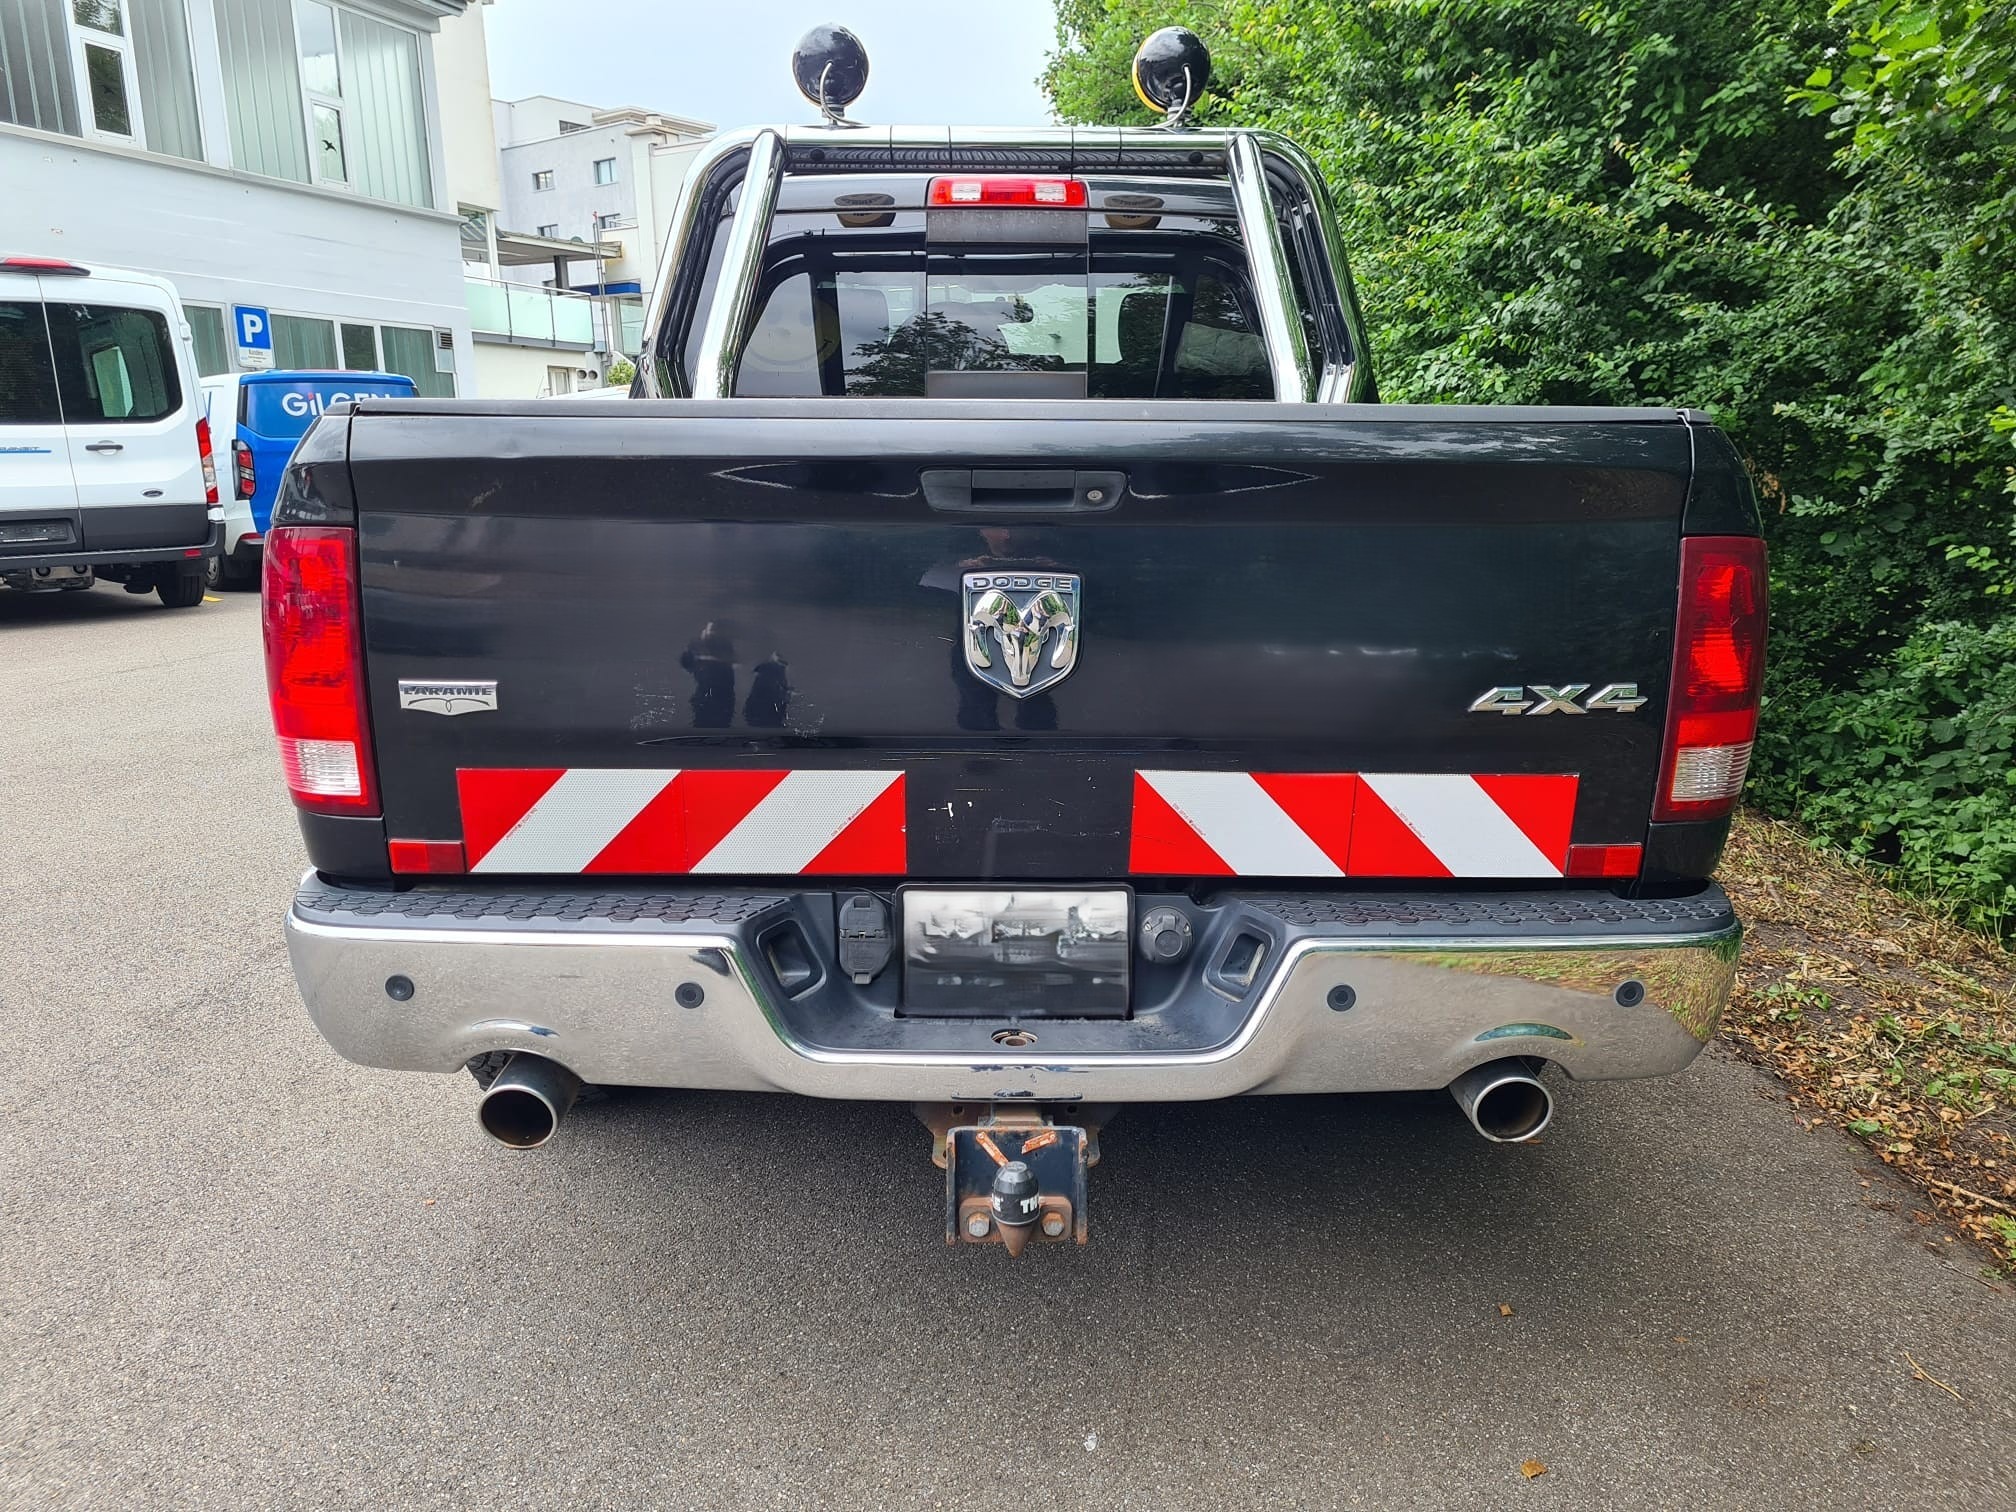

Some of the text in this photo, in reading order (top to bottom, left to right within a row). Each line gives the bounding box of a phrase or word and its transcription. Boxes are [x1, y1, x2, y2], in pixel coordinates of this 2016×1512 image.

[242, 313, 263, 343] P
[972, 576, 1073, 590] DODGE
[403, 686, 494, 696] LARAMIE
